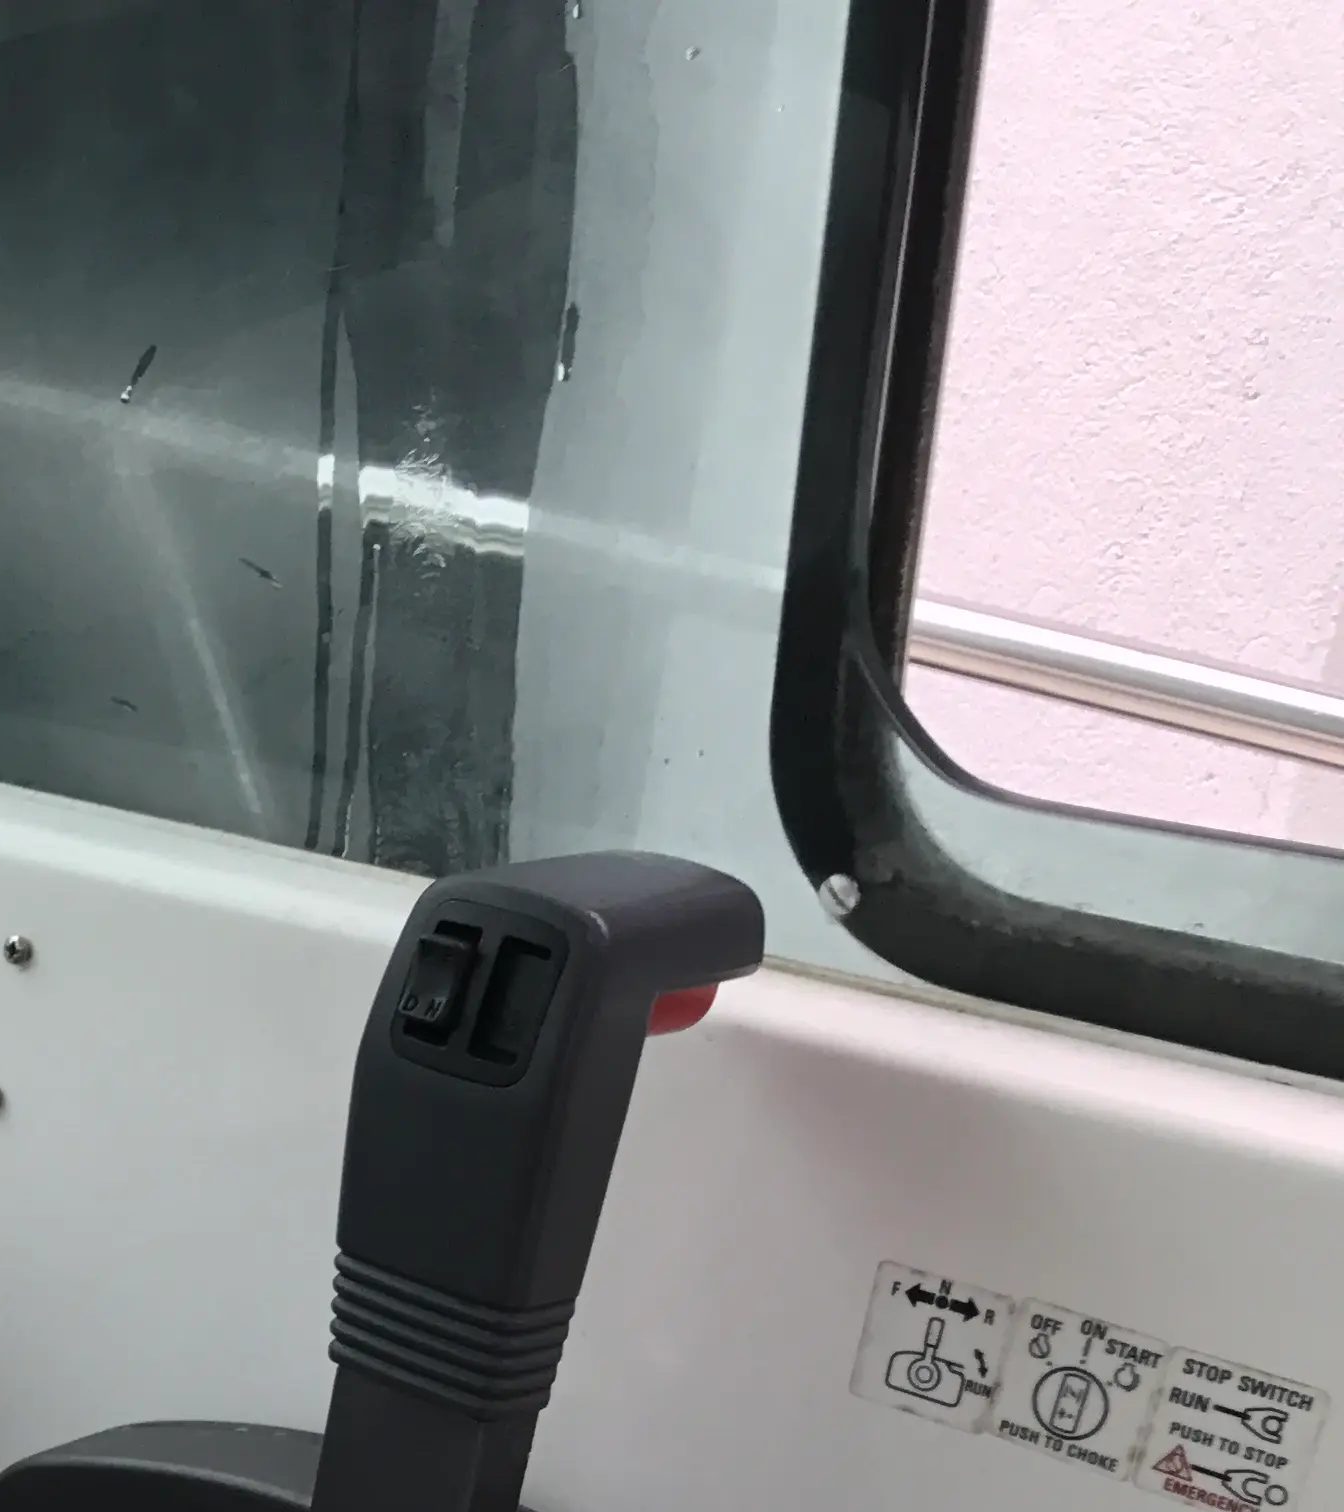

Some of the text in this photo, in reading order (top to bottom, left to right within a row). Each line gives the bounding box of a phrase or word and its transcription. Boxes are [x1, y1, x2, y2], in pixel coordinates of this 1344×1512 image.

[891, 1281, 901, 1297] F
[939, 1279, 953, 1295] N
[983, 1309, 995, 1325] R
[1030, 1314, 1064, 1335] OFF
[1080, 1319, 1108, 1340] ON
[1105, 1338, 1164, 1369] START
[965, 1379, 992, 1399] RUN
[1182, 1358, 1315, 1412] STOP SWITCH
[1169, 1386, 1210, 1413] RUN
[998, 1419, 1120, 1473] PUSH TO CHOKE
[1169, 1421, 1288, 1471] PUSH TO STOP
